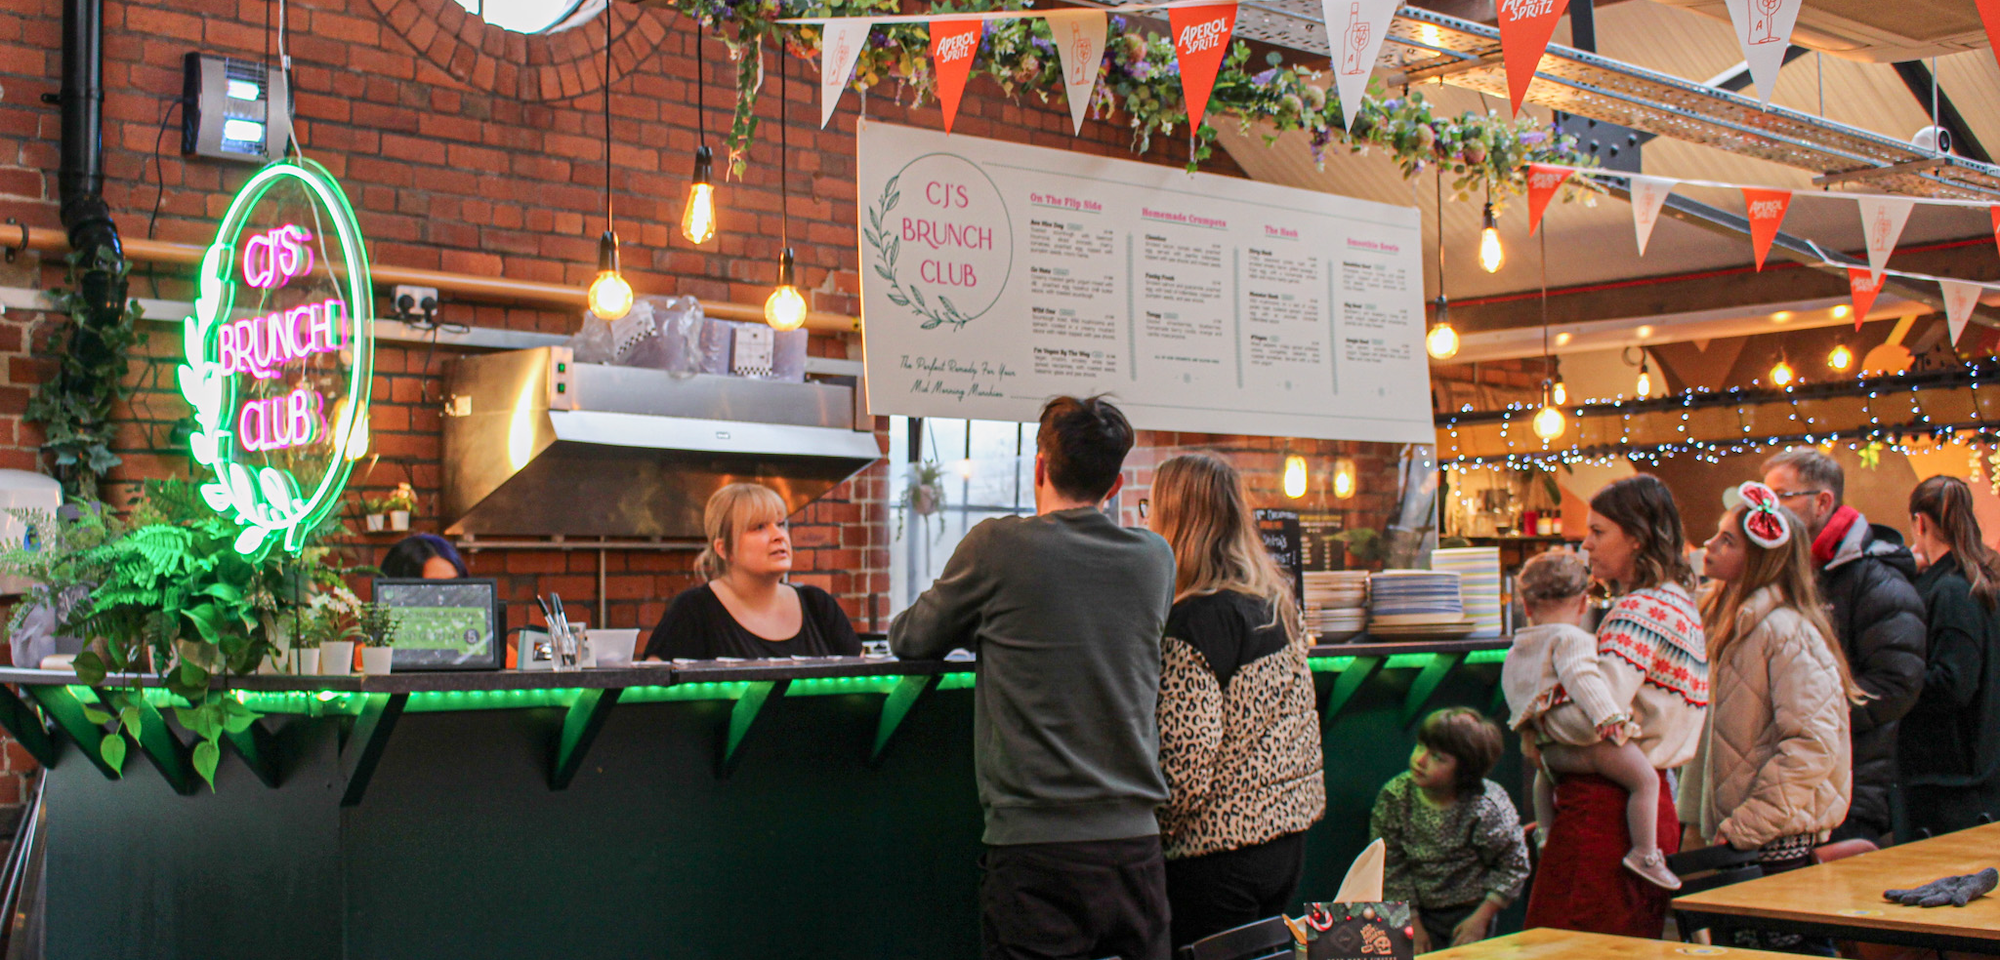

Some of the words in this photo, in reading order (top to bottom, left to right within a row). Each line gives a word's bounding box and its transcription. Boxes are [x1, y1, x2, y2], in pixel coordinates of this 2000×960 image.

[1509, 0, 1554, 21] SPRITZ
[1178, 17, 1228, 47] APEROL
[936, 31, 976, 57] APEROL
[942, 45, 969, 63] SPRITZ
[1185, 34, 1219, 55] SPRITZ
[926, 181, 969, 208] CJ'S
[1030, 193, 1043, 203] On
[1045, 195, 1062, 206] The
[1065, 197, 1081, 210] Flip
[1083, 200, 1102, 211] Side
[1142, 207, 1187, 221] Homemade
[1189, 214, 1226, 228] Crumpets
[1749, 200, 1783, 214] APEROL
[903, 217, 992, 250] BRUNCH
[1265, 225, 1278, 235] The
[1347, 237, 1378, 249] Smoothie
[242, 223, 305, 288] CJ'S
[921, 259, 977, 287] CLUB
[218, 299, 341, 379] BRUNCH
[901, 355, 912, 369] The
[916, 357, 945, 378] Perfect
[948, 359, 977, 381] Remedy
[982, 361, 995, 375] For
[998, 362, 1016, 382] Your
[910, 379, 930, 393] Mid
[931, 380, 965, 402] Morning
[239, 388, 317, 451] CLUB
[467, 629, 478, 643] 5
